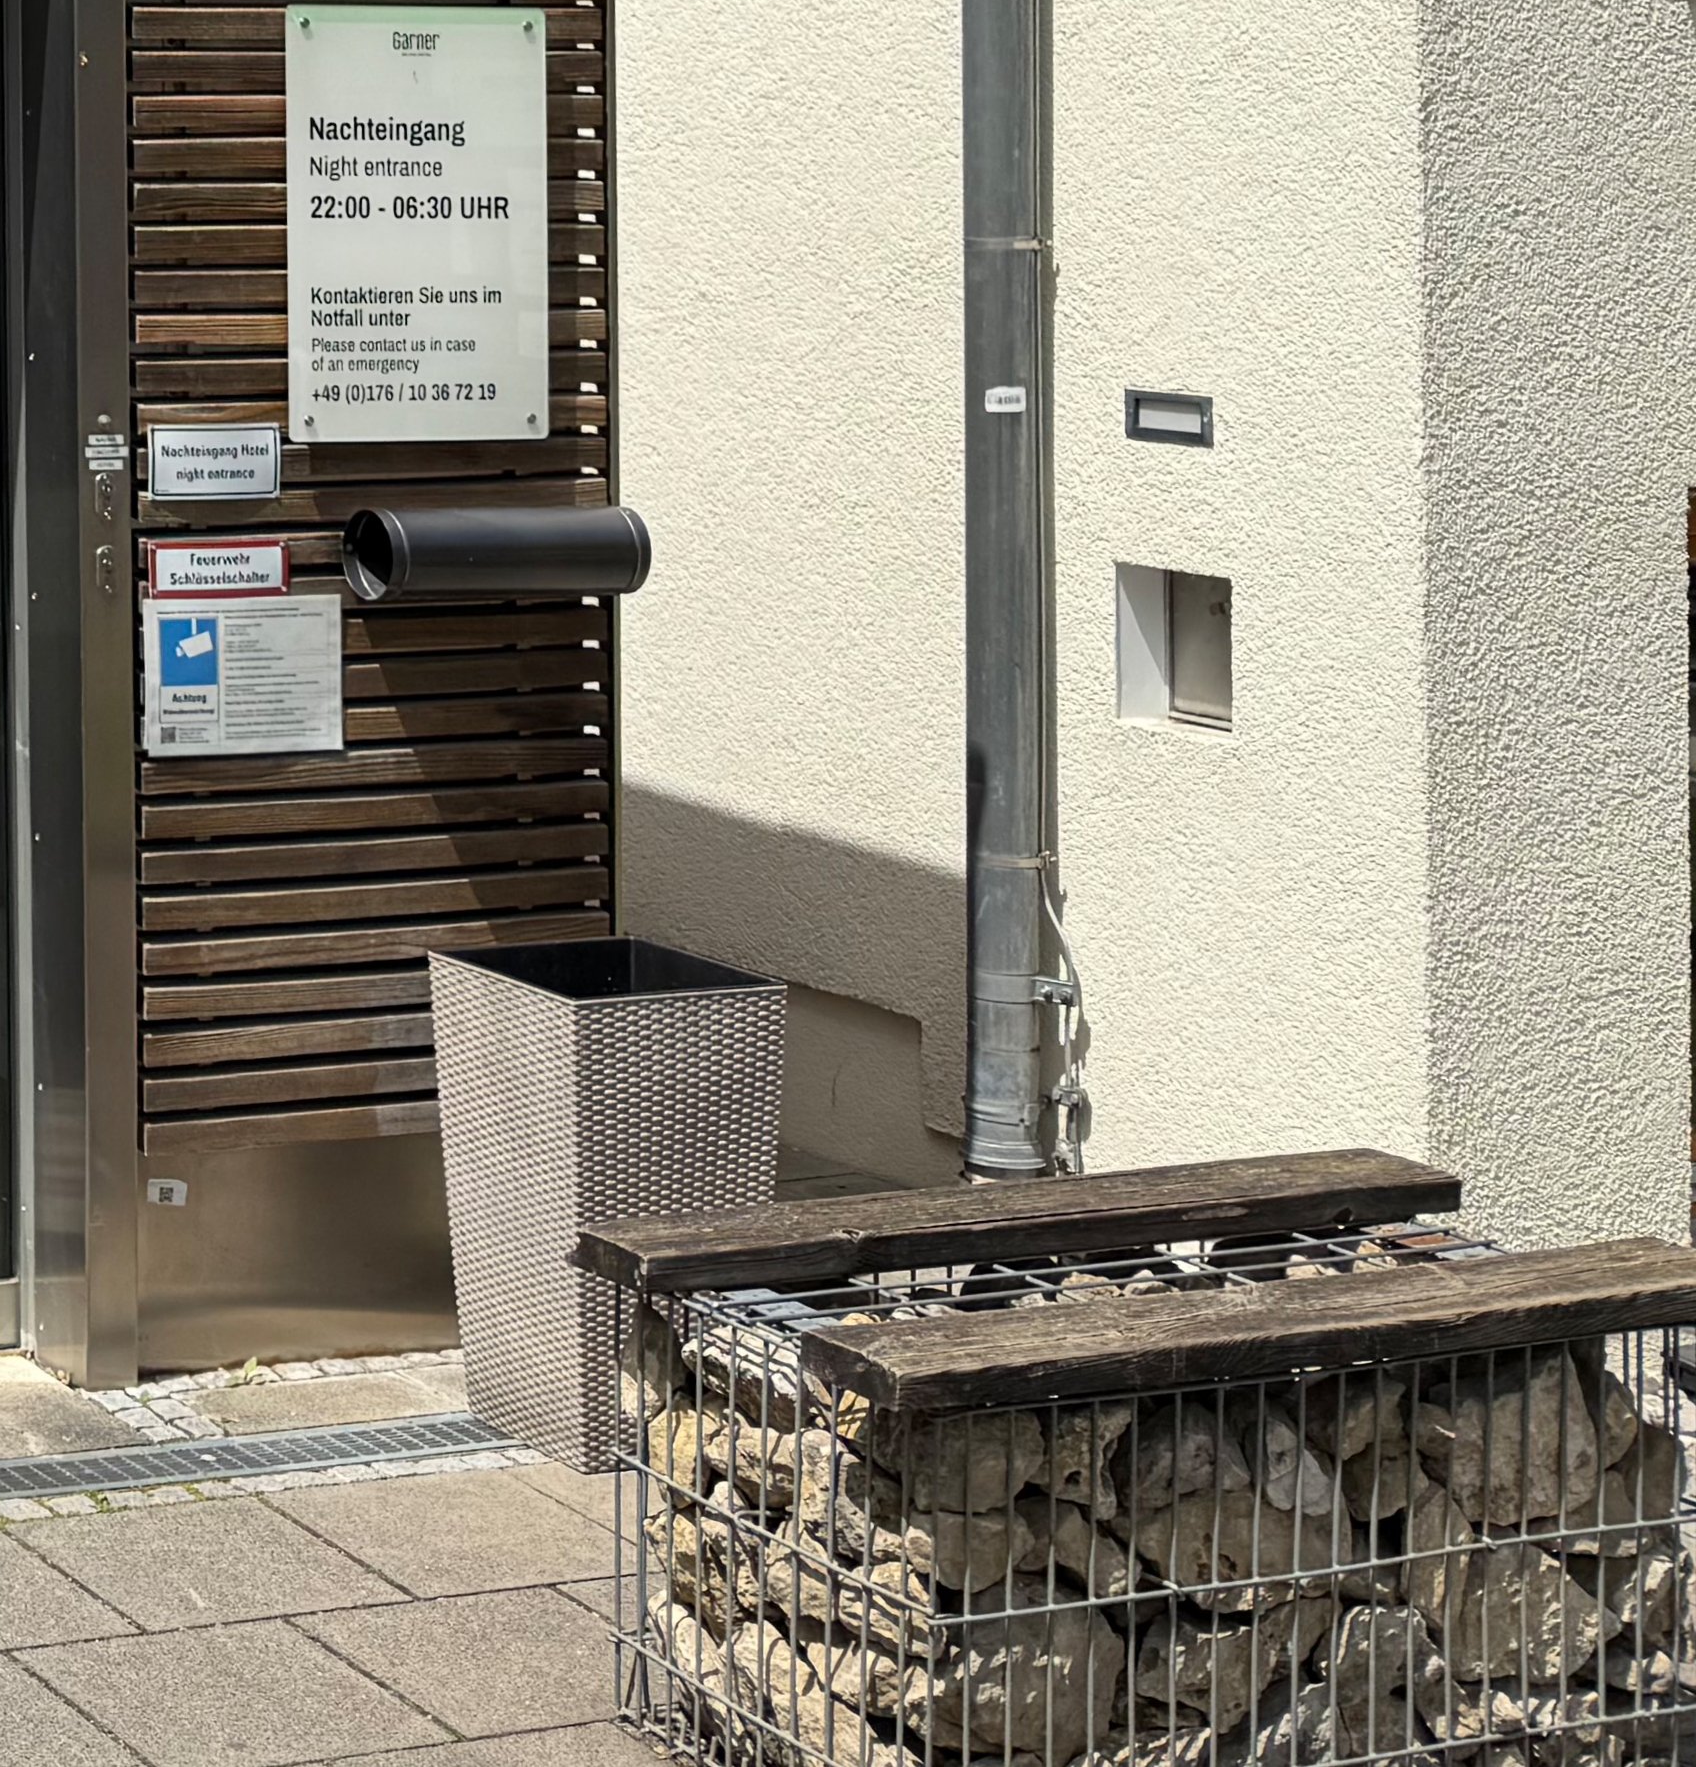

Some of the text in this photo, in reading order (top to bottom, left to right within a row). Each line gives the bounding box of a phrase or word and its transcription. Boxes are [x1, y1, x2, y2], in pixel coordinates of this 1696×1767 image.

[392, 31, 440, 51] Garner
[309, 116, 466, 147] Nachteingang
[309, 155, 443, 182] Night entrance
[310, 195, 371, 219] 22:00
[392, 195, 452, 220] 06:30
[460, 196, 510, 220] UHR
[310, 285, 502, 305] Kontaktieren Sie uns im
[311, 308, 411, 327] Notfall unter
[311, 337, 476, 353] Please contact us in case
[311, 355, 420, 375] of an emergency
[311, 384, 341, 402] +49
[345, 384, 394, 405] (0)176
[408, 383, 427, 402] 10
[431, 383, 450, 401] 36
[454, 383, 474, 401] 72
[478, 383, 497, 401] 19
[161, 443, 269, 461] Nachteingang Hotel
[176, 467, 256, 483] night entrance
[190, 552, 251, 567] Feuerwehr
